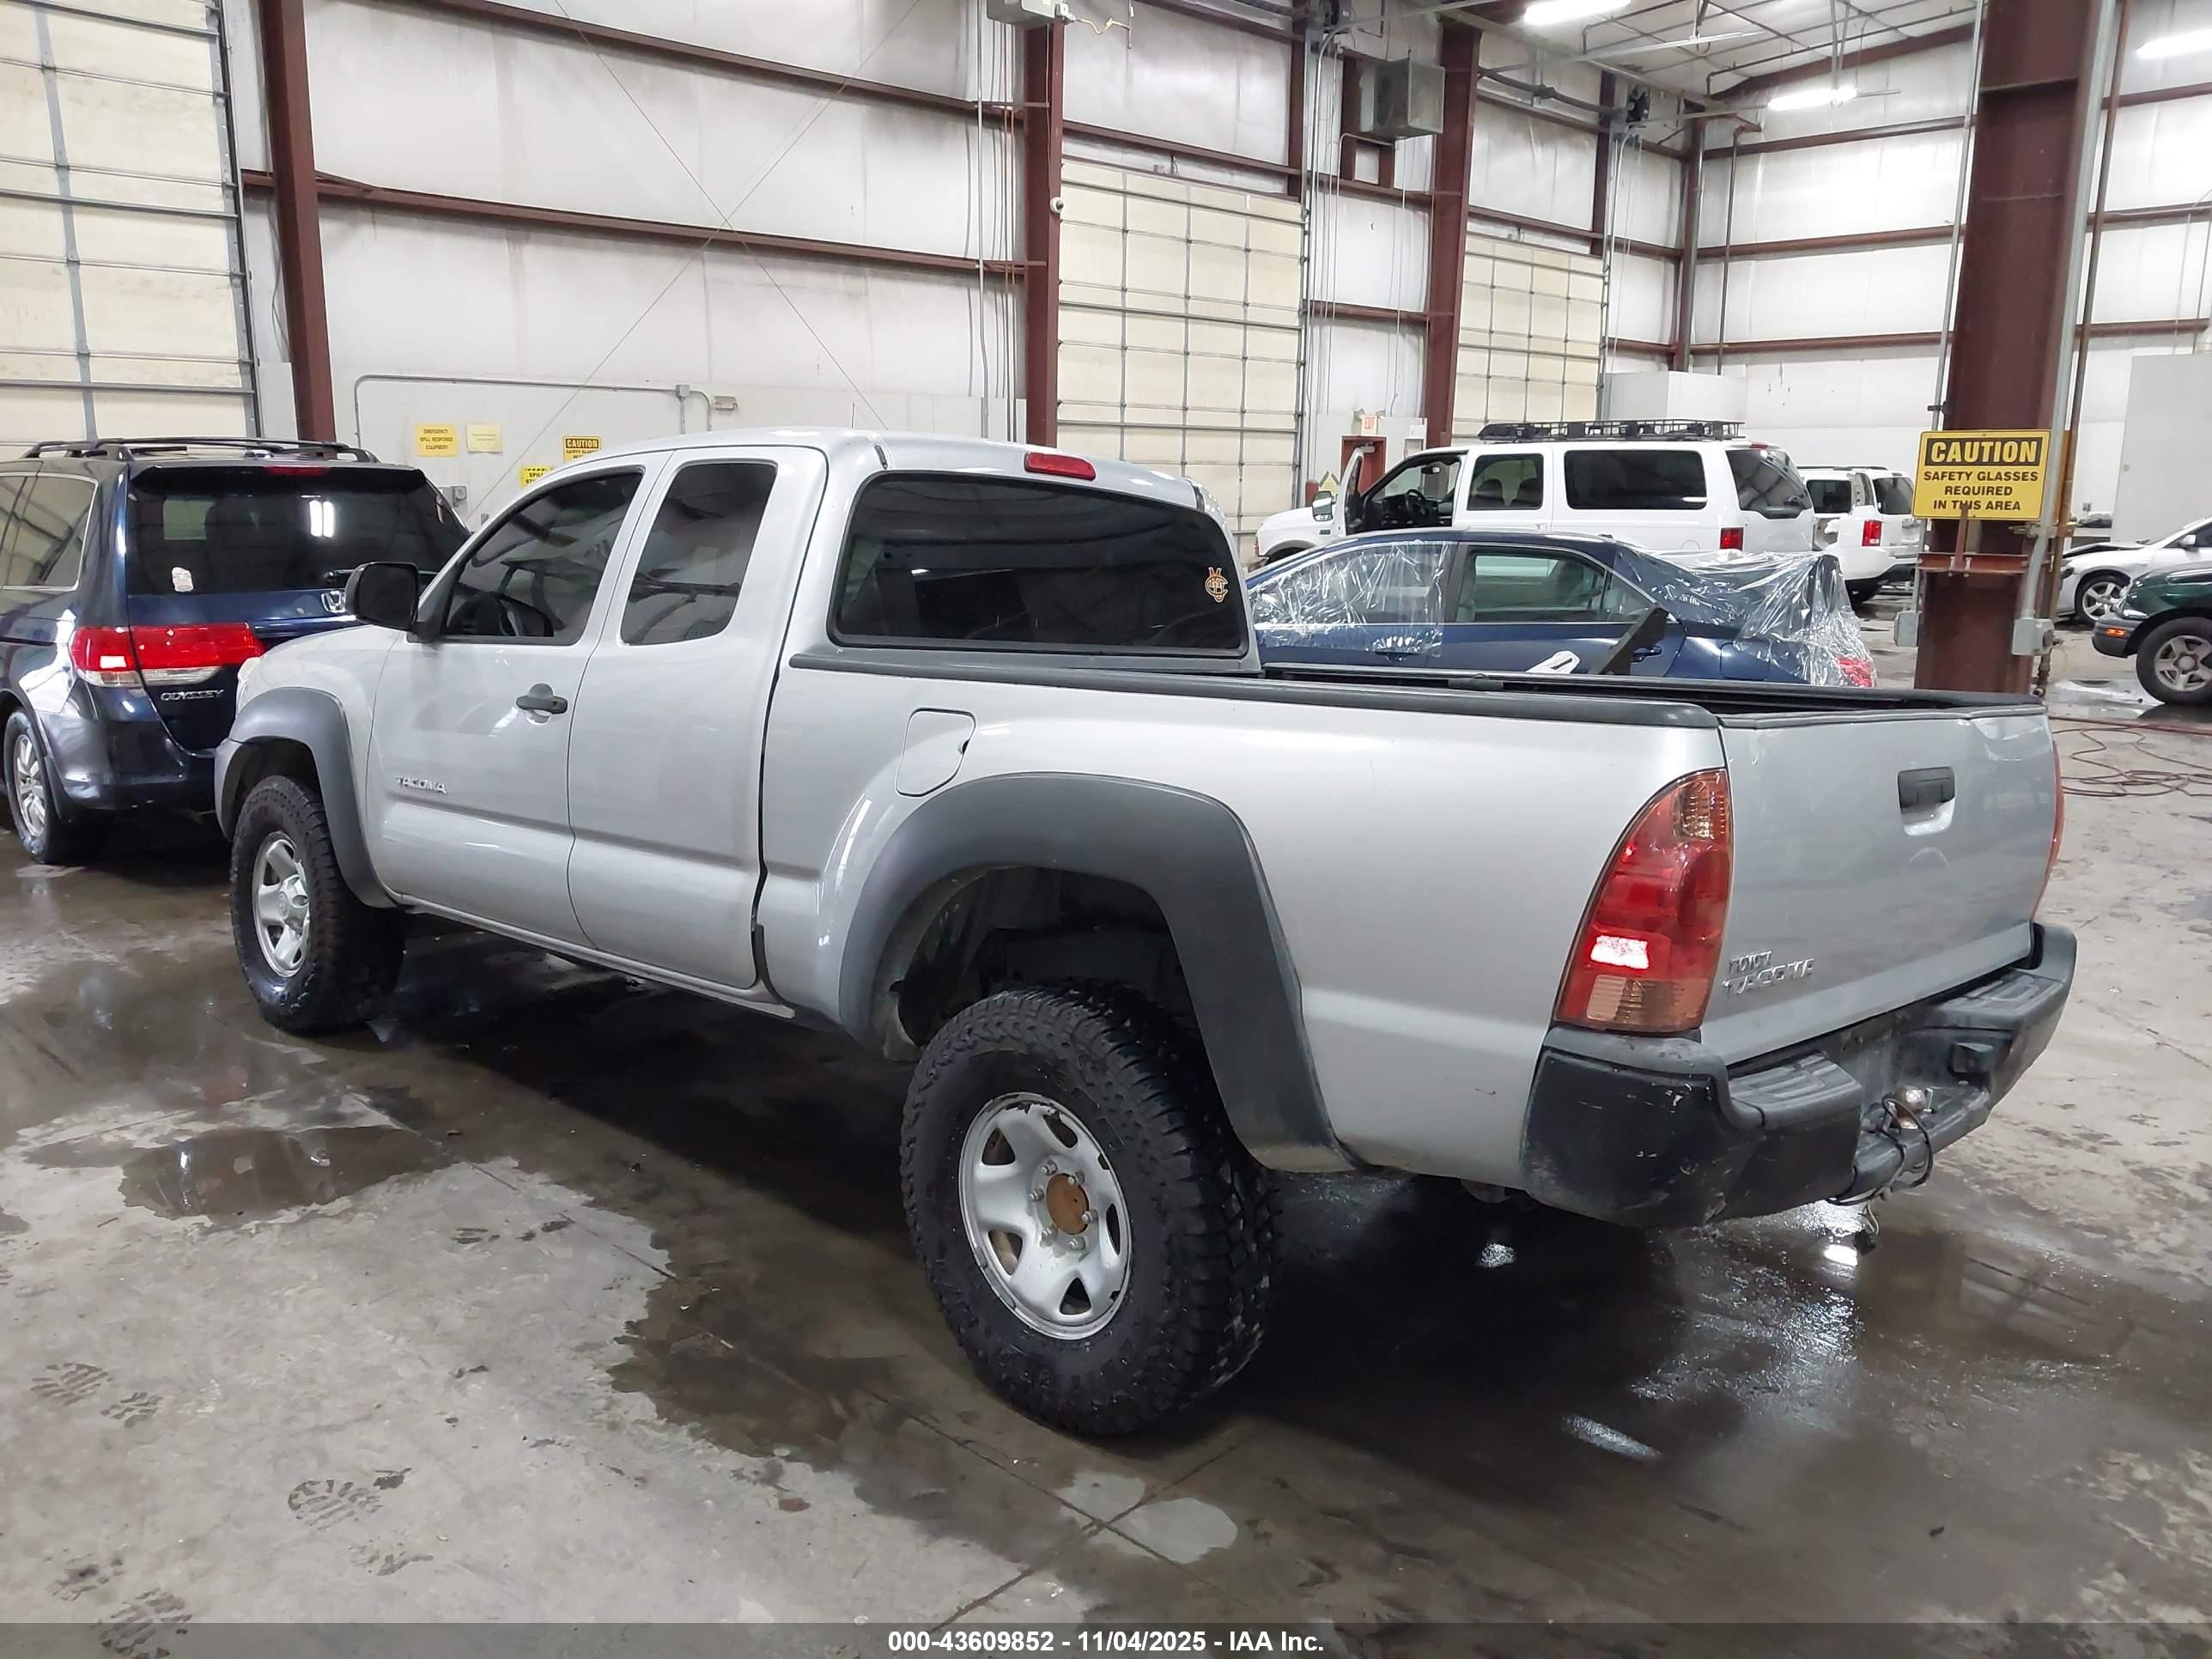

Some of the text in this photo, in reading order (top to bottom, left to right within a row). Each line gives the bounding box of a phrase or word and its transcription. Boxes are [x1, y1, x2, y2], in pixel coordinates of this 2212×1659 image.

[567, 439, 599, 448] CAUTION
[1931, 441, 2038, 463] CAUTION
[1923, 471, 2039, 482] SAFETY GLASSES
[1944, 486, 2013, 495] REQUIRED
[1933, 500, 1947, 509] IN
[1985, 501, 2021, 511] AREA
[161, 690, 224, 701] ODYSSEY
[395, 776, 447, 794] TACOMA
[1722, 957, 1814, 996] TACOMA
